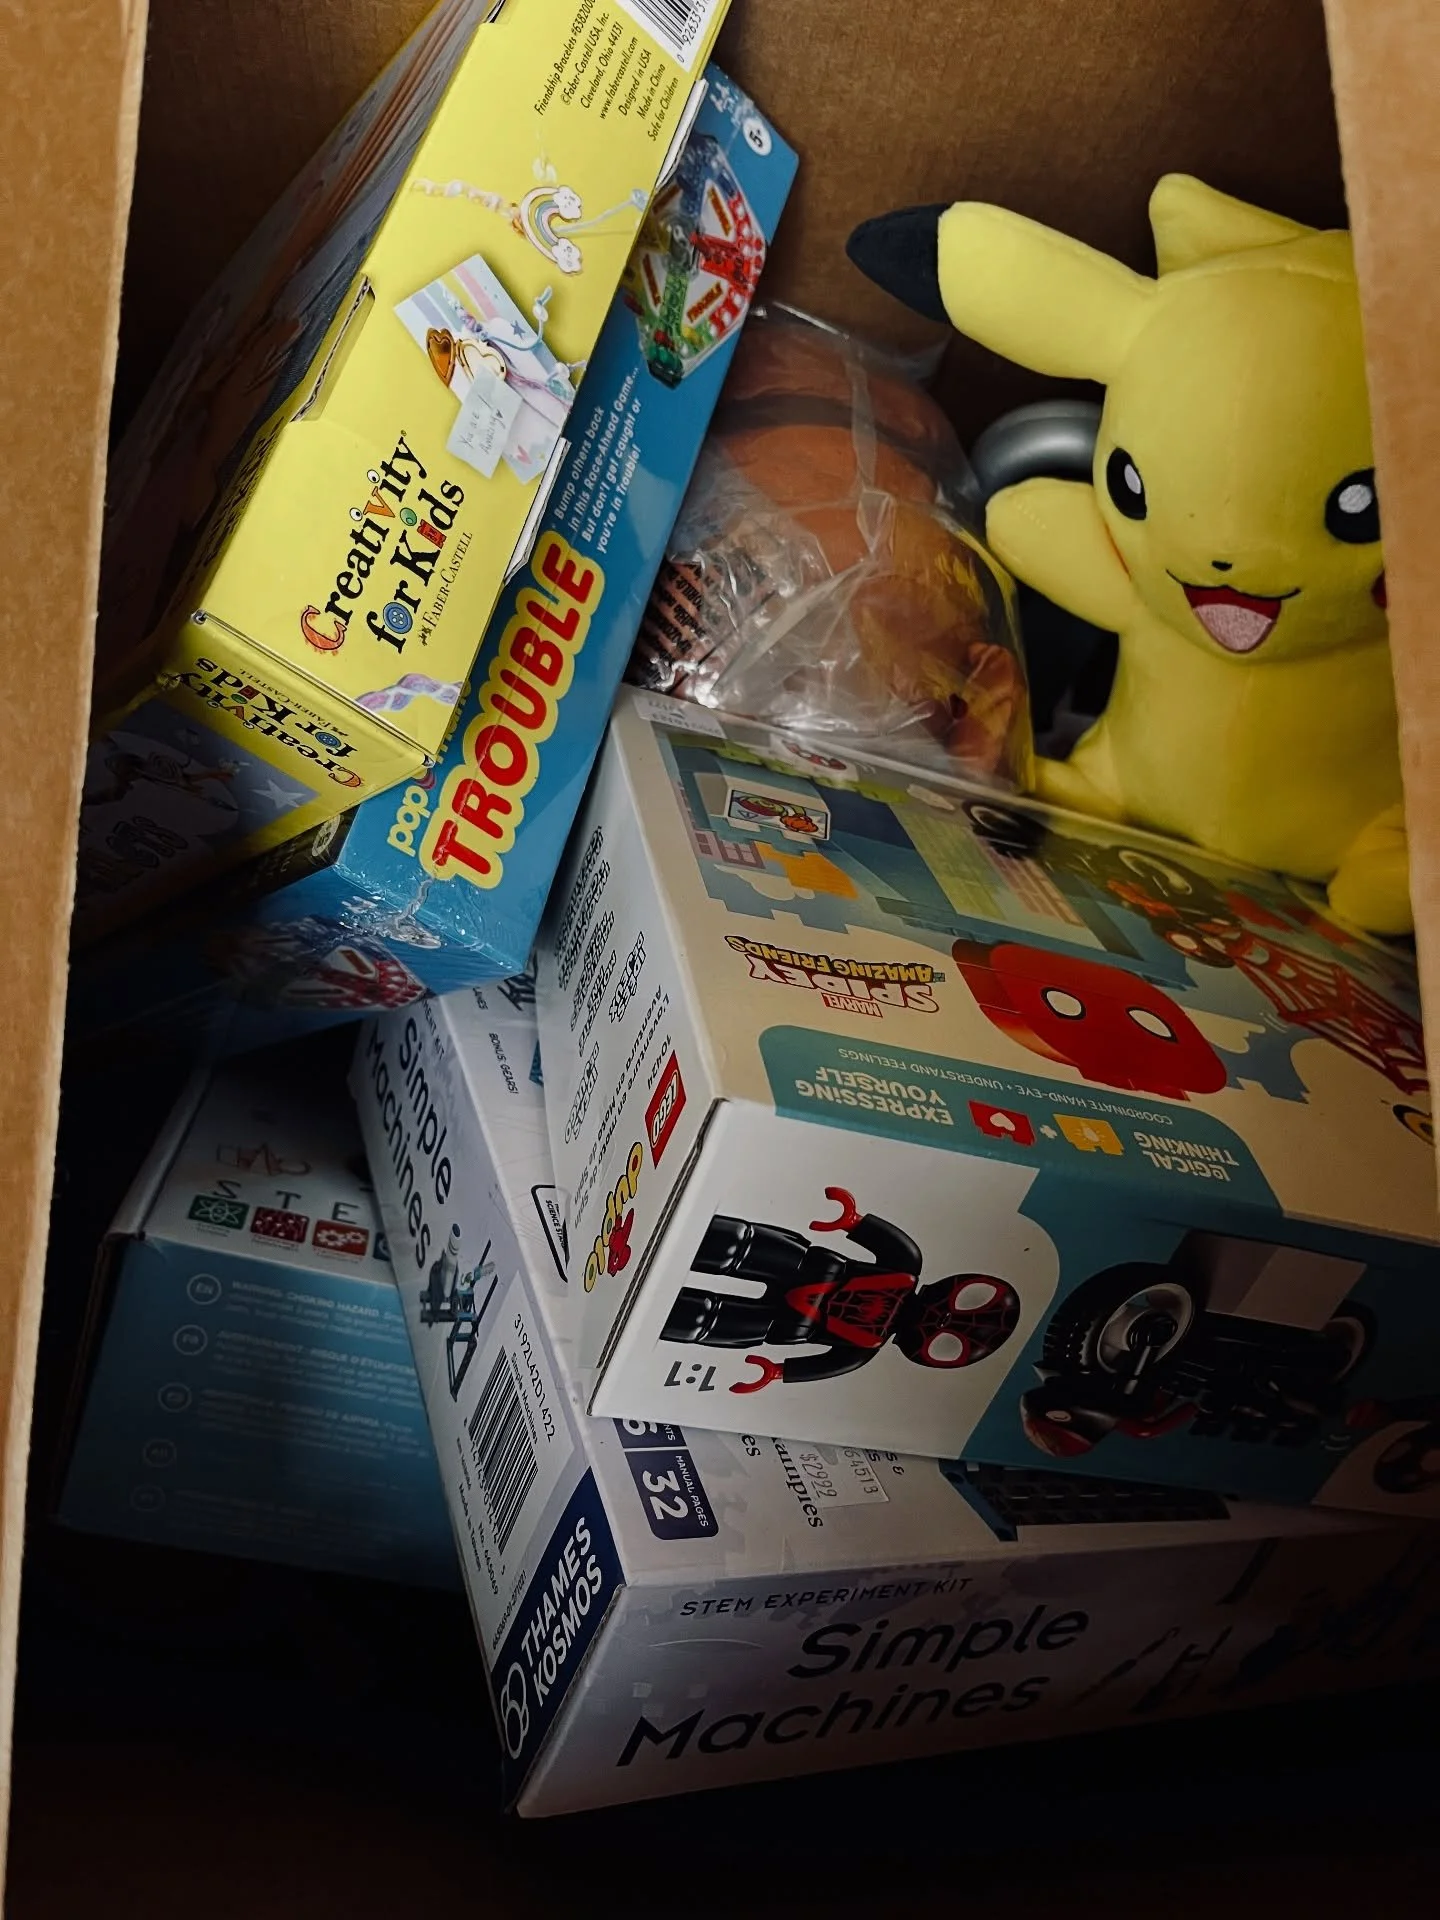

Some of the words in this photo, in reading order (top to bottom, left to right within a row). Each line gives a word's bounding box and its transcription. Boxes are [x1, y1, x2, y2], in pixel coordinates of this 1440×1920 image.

[587, 26, 603, 46] USA,
[596, 13, 609, 26] Inc.
[680, 11, 701, 45] 92633
[534, 73, 561, 115] Friendship
[554, 37, 576, 73] Bracelets
[581, 66, 605, 108] Cleveland,
[599, 48, 613, 66] Ohio
[608, 22, 623, 46] 44131
[600, 37, 637, 119] www.fabercastell.com
[635, 69, 644, 78] in
[638, 49, 651, 68] USA
[650, 64, 665, 87] China
[618, 75, 639, 116] Designed
[637, 96, 652, 119] Made
[647, 87, 655, 96] in
[648, 122, 660, 140] Safe
[655, 110, 665, 122] for
[660, 78, 678, 110] Children
[554, 483, 575, 519] Bump
[572, 440, 591, 480] others
[586, 407, 604, 439] back
[568, 517, 580, 532] in
[574, 491, 590, 515] this
[584, 413, 619, 489] Race-Ahead
[614, 368, 638, 411] Game...
[582, 518, 596, 542] But
[593, 482, 610, 517] don't
[607, 458, 618, 483] get
[615, 413, 635, 458] caught
[632, 398, 641, 413] or
[615, 444, 640, 495] Trouble!
[611, 497, 622, 511] in
[300, 436, 428, 654] Creativity
[390, 480, 465, 588] Kids
[597, 512, 616, 551] you're
[424, 530, 473, 629] FABER-CASTELL
[366, 580, 421, 654] for
[195, 657, 298, 734] Kids
[240, 668, 332, 729] FABER-CASTELL
[432, 543, 595, 875] TROUBLE
[177, 671, 363, 788] Creativity
[299, 723, 358, 758] for
[387, 785, 428, 858] pop
[726, 935, 833, 975] FRIENDS
[833, 957, 934, 984] AMAZING
[745, 954, 939, 1013] SPIDEY
[609, 952, 635, 1023] JEUX
[822, 993, 883, 1018] MARVEL
[625, 984, 662, 1071] Aventura
[628, 993, 669, 1090] L'aventure
[500, 1064, 518, 1093] GEARS!
[616, 1072, 625, 1095] en
[647, 1034, 672, 1090] 10424
[816, 1066, 947, 1107] YOURSELF
[838, 1048, 906, 1071] FEELINGS
[910, 1061, 1003, 1090] UNDERSTAND
[400, 1017, 452, 1205] Simple
[597, 1096, 615, 1141] Moto
[617, 1092, 627, 1115] en
[651, 1069, 679, 1149] LEGO
[1017, 1083, 1086, 1110] HAND-EYE
[1087, 1098, 1173, 1125] COORDINATE
[370, 1021, 430, 1269] Machines
[589, 1141, 597, 1162] de
[598, 1115, 617, 1165] moto
[213, 1180, 242, 1199] S
[277, 1191, 302, 1210] T
[331, 1202, 360, 1223] E
[575, 1167, 589, 1206] Spin
[589, 1165, 598, 1185] de
[546, 1200, 560, 1226] SCIENCE
[575, 1191, 589, 1229] Spin
[584, 1141, 643, 1293] duplo
[511, 1352, 523, 1390] Simple
[522, 1389, 537, 1444] Machines
[664, 1360, 717, 1392] 1:1
[642, 1469, 689, 1521] 32
[676, 1455, 695, 1495] MANUAL
[691, 1495, 709, 1528] PAGES
[772, 1437, 824, 1529] amples
[459, 1482, 469, 1517] Made
[471, 1527, 482, 1572] Taiwan
[521, 1515, 592, 1668] THAMES
[680, 1599, 753, 1616] STEM
[764, 1581, 931, 1610] EXPERIMENT
[934, 1577, 974, 1593] KIT
[533, 1554, 603, 1707] KOSMOS
[787, 1604, 1089, 1679] Simple
[615, 1675, 1051, 1767] Machines
